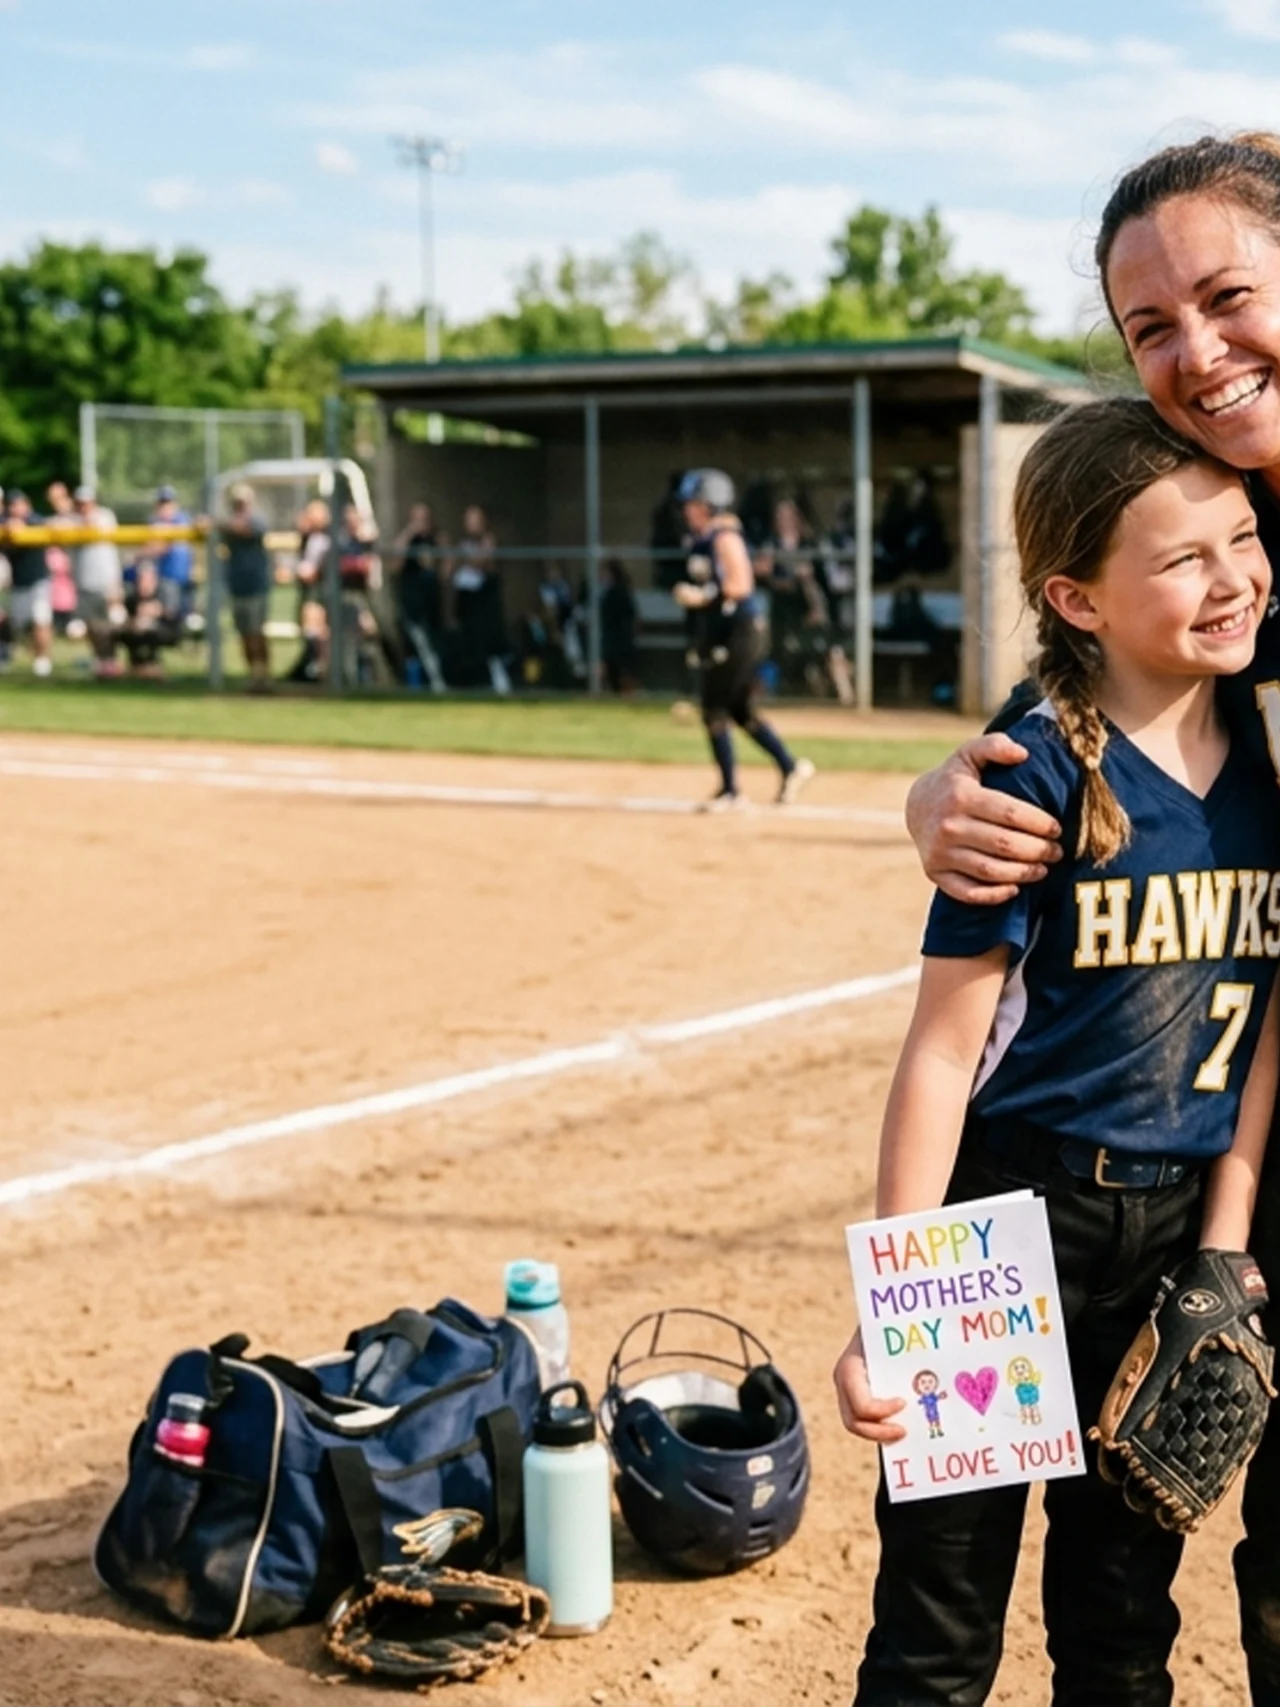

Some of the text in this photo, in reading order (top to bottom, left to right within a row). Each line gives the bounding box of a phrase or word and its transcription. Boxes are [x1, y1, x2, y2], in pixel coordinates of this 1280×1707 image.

[1193, 982, 1255, 1091] 7
[869, 1218, 993, 1275] HAPPY
[870, 1263, 1023, 1318] MOTHER'S
[883, 1296, 1051, 1356] DAY MOM!
[893, 1430, 1078, 1489] I LOVE YOU!
